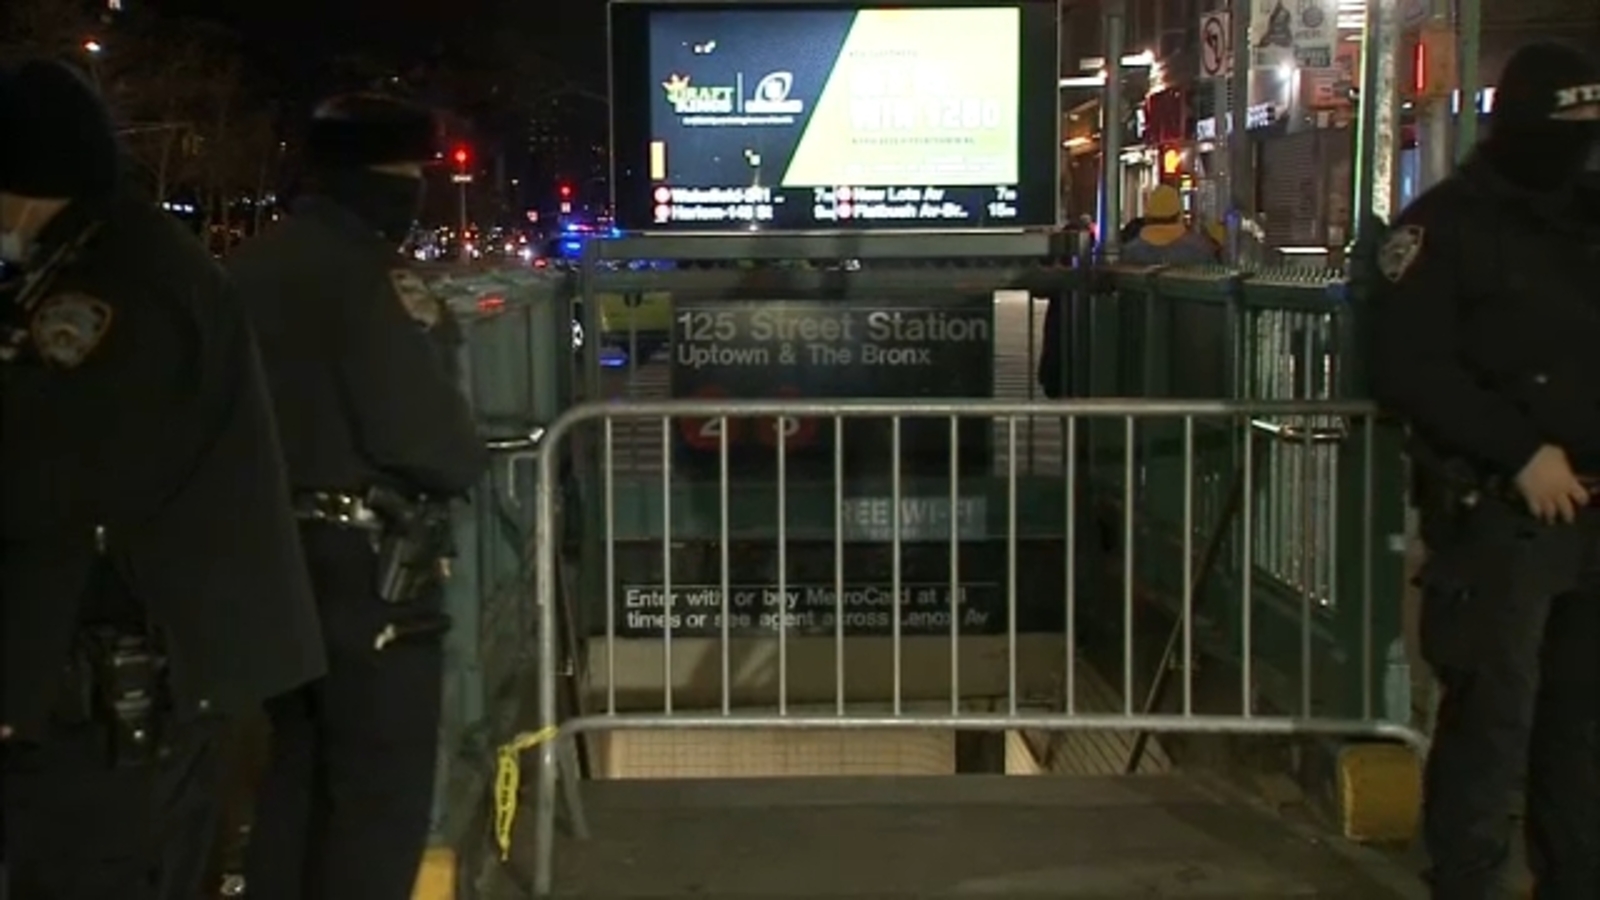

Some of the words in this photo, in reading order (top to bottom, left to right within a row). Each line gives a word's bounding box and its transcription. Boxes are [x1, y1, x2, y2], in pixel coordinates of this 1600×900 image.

[853, 187, 886, 201] New
[923, 187, 945, 201] Av
[677, 311, 736, 341] 125
[749, 310, 855, 342] Street
[867, 310, 988, 342] Station
[677, 343, 769, 368] Uptown
[779, 343, 797, 365] &
[810, 343, 852, 365] The
[861, 343, 932, 365] Bronx
[838, 498, 888, 526] REE
[626, 589, 679, 607] Enter
[686, 589, 724, 606] with
[734, 591, 755, 606] or
[762, 589, 800, 609] buy
[806, 587, 911, 606] MeroCad
[917, 588, 937, 605] at
[627, 610, 681, 628] times
[686, 612, 707, 628] or
[714, 612, 751, 628] see
[759, 611, 815, 631] agent
[822, 611, 889, 627] aross
[964, 608, 989, 627] Av
